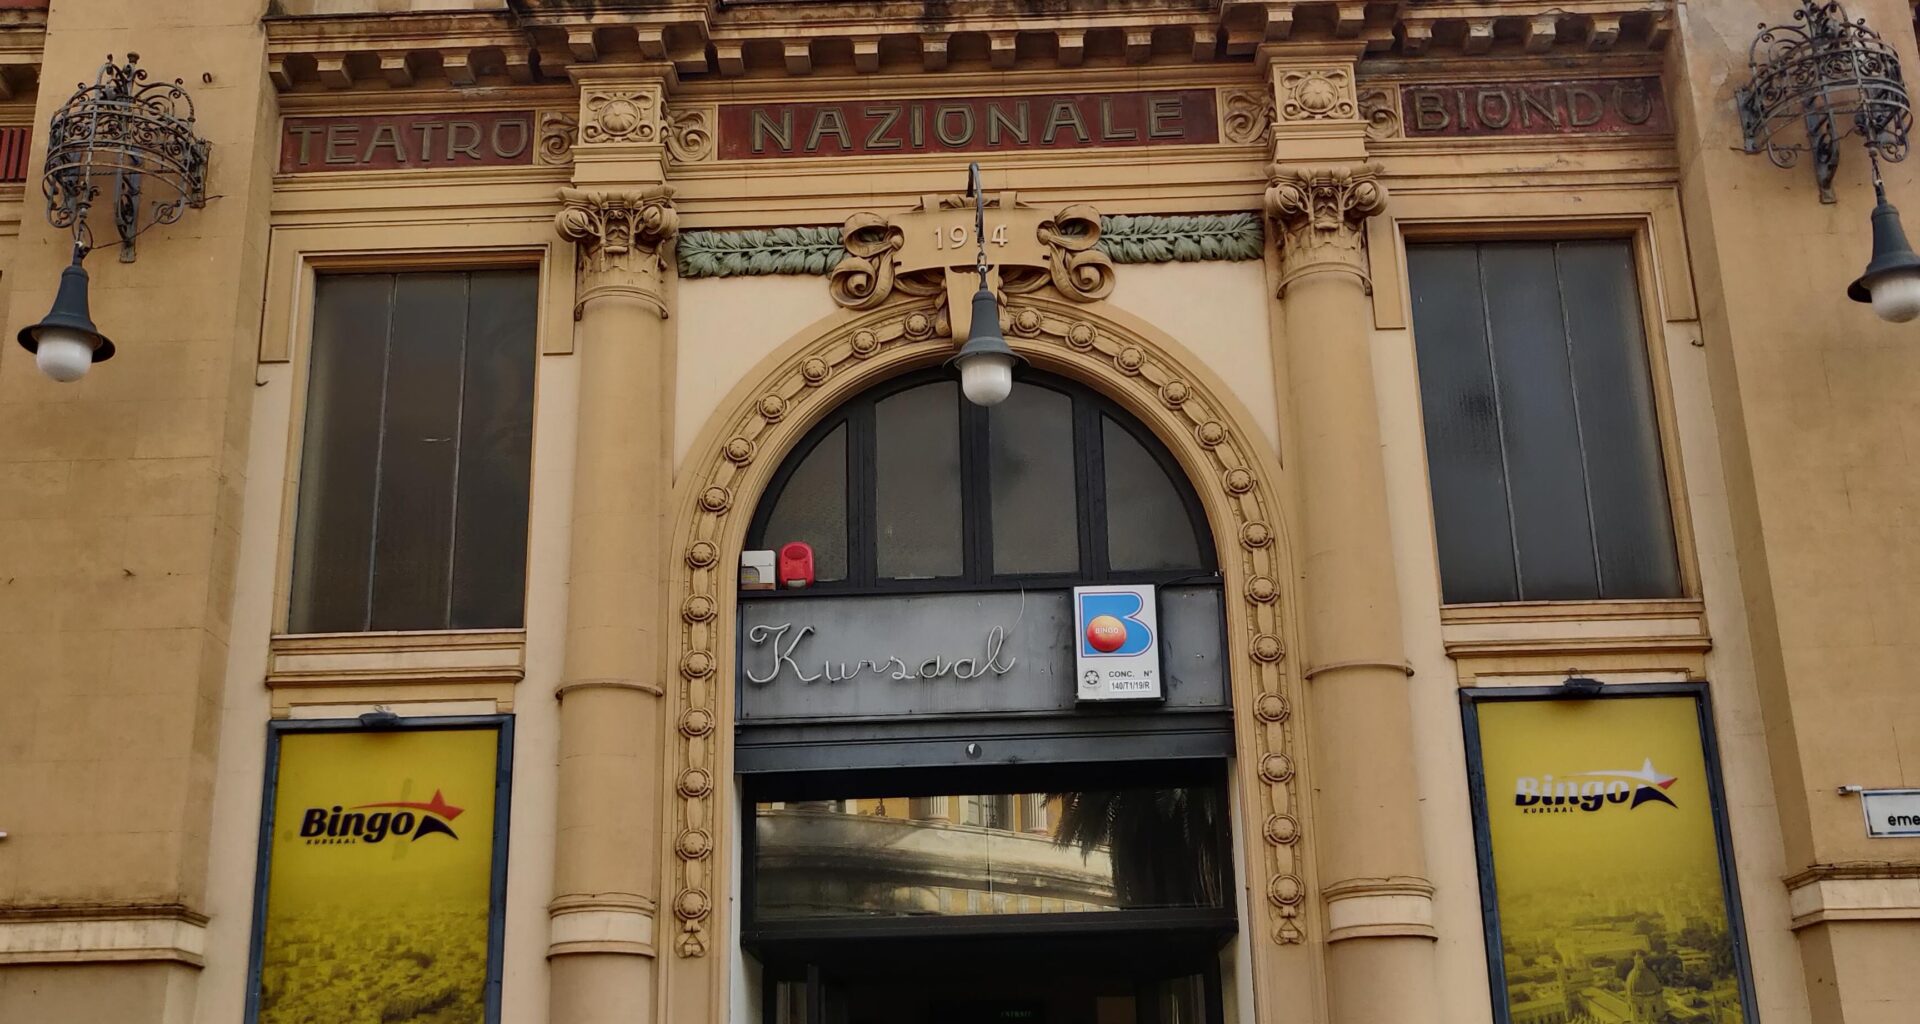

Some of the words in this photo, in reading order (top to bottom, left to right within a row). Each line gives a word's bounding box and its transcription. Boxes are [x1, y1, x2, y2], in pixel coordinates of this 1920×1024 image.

[289, 119, 528, 165] TEATRO
[751, 96, 1187, 153] NAZIONALE
[1413, 84, 1652, 131] BIONDO
[934, 224, 1009, 250] 194
[746, 622, 1017, 684] Kursaal
[1108, 670, 1135, 678] CONC.
[1515, 774, 1631, 812] Bingo
[300, 805, 416, 843] Bingo
